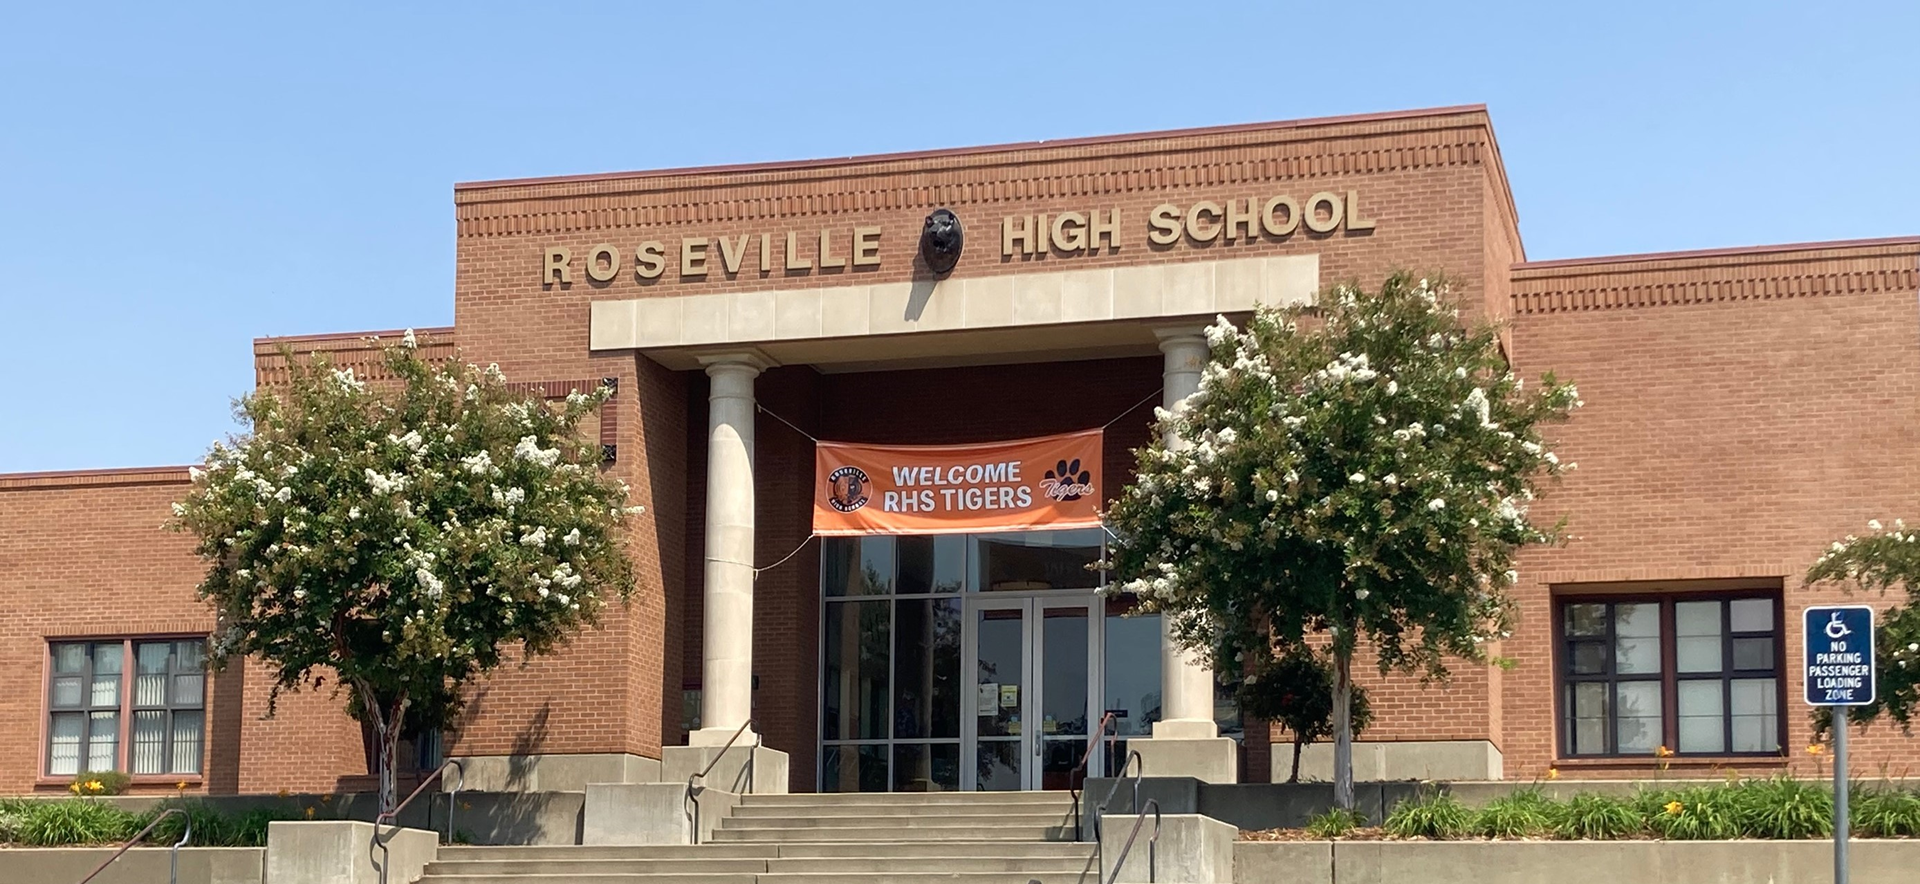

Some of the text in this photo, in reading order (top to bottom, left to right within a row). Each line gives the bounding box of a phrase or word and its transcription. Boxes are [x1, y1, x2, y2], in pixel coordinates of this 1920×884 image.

[543, 190, 1376, 284] ROSEVILLE HIGH SCHOOL
[892, 461, 1022, 487] WELCOME
[1039, 478, 1095, 502] Tigers
[883, 486, 1032, 513] RHS TIGERS
[1830, 641, 1847, 652] NO
[1816, 653, 1862, 664] PARKING
[1809, 665, 1869, 677] PASSENGER
[1817, 677, 1862, 689] LOADING
[1825, 689, 1854, 700] ZONE
